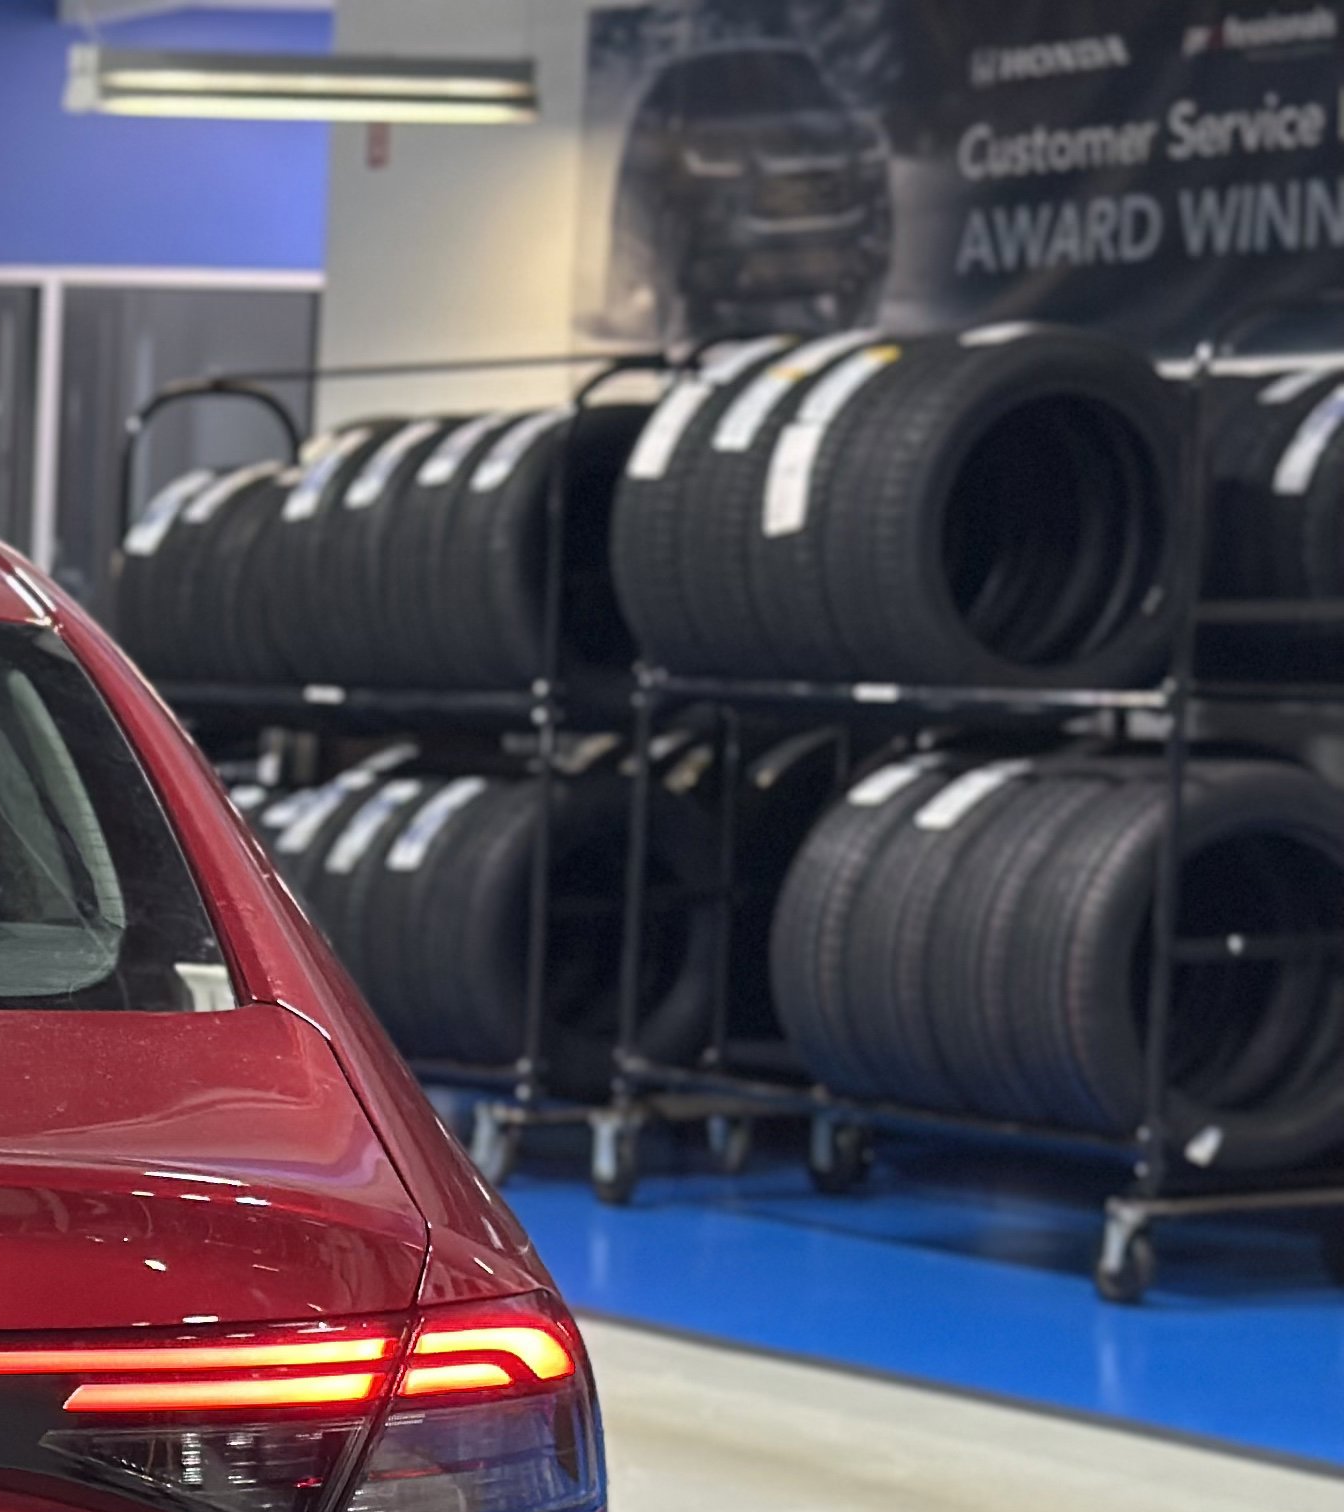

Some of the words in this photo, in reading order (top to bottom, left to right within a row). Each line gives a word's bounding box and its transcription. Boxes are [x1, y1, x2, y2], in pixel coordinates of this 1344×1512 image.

[999, 34, 1130, 80] HONDA
[958, 122, 1159, 179] Customer
[1166, 92, 1325, 160] Service
[955, 194, 1162, 274] AWARD
